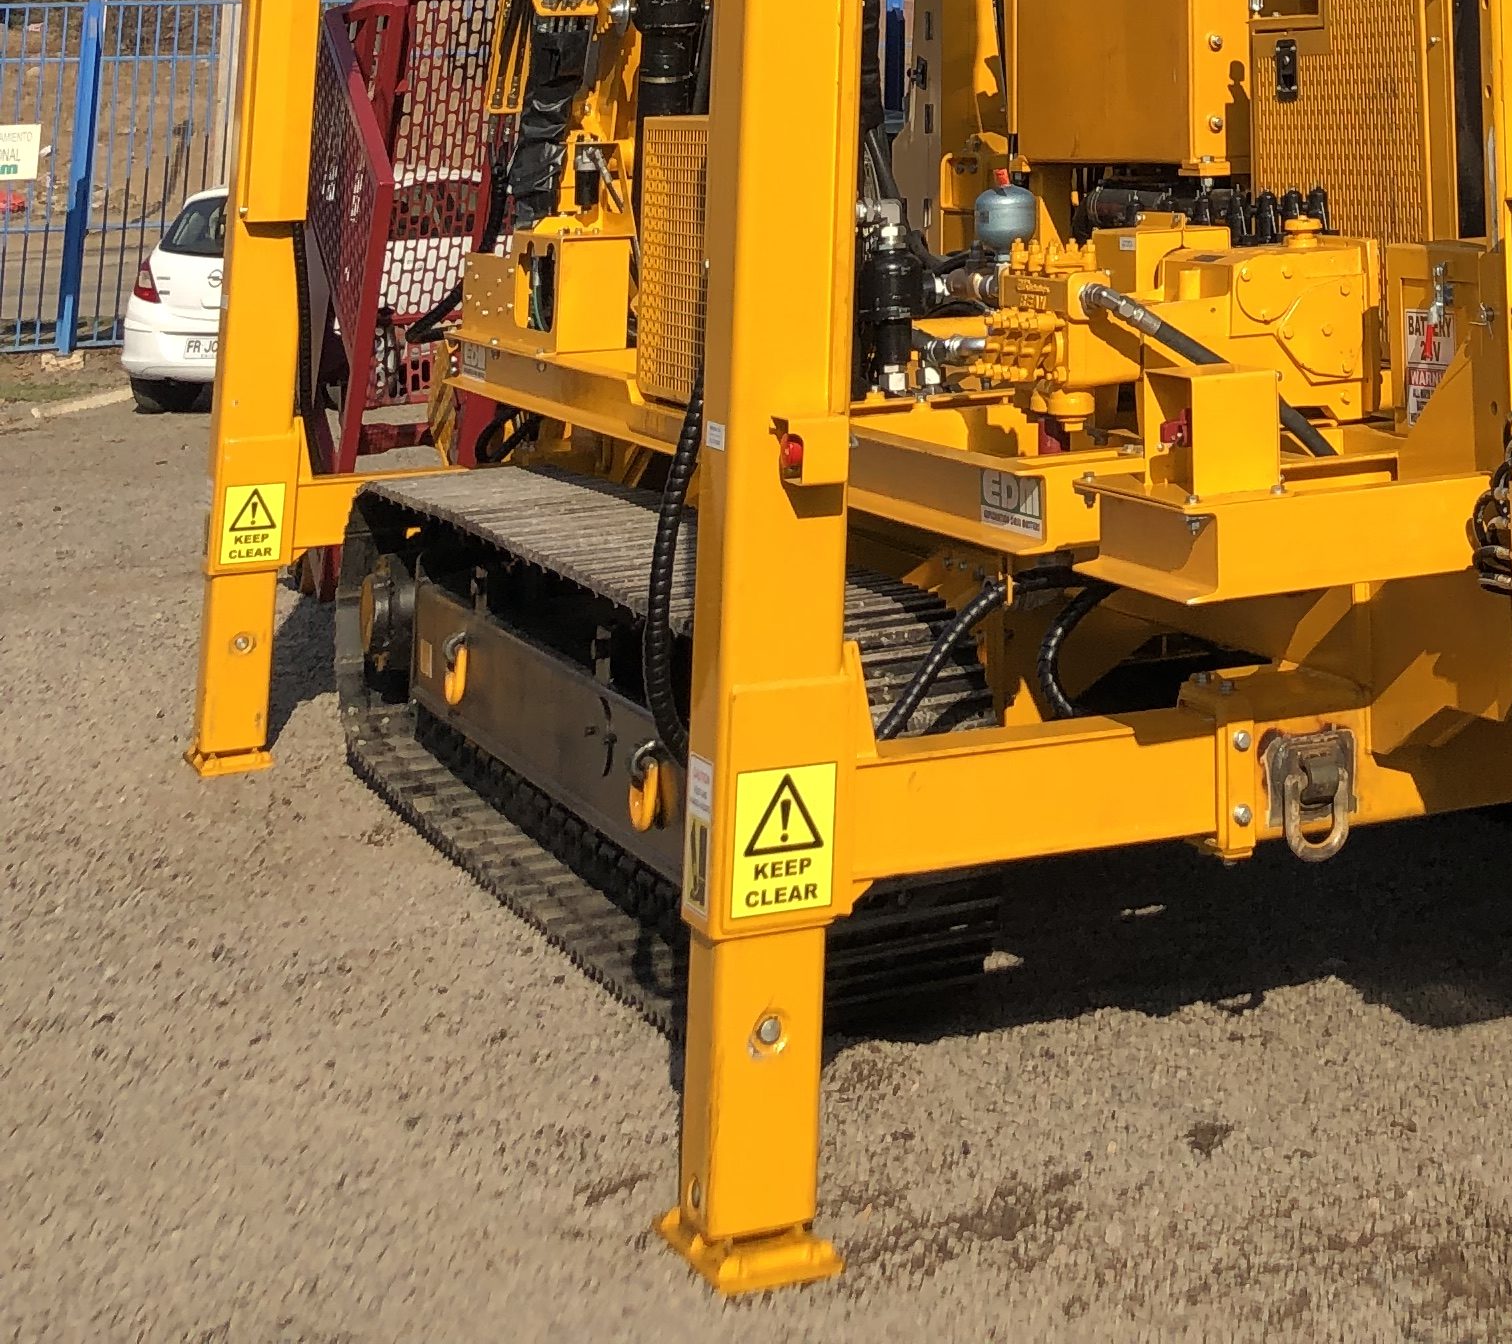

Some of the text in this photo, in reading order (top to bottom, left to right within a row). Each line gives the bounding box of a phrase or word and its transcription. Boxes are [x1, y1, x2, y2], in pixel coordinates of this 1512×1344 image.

[1408, 315, 1452, 338] BATERY
[186, 340, 202, 353] FR
[982, 468, 1040, 517] EDM
[234, 534, 270, 545] KEEP
[228, 547, 272, 559] CLEAR
[753, 858, 812, 881] KEEP
[745, 883, 818, 907] CLEAR
